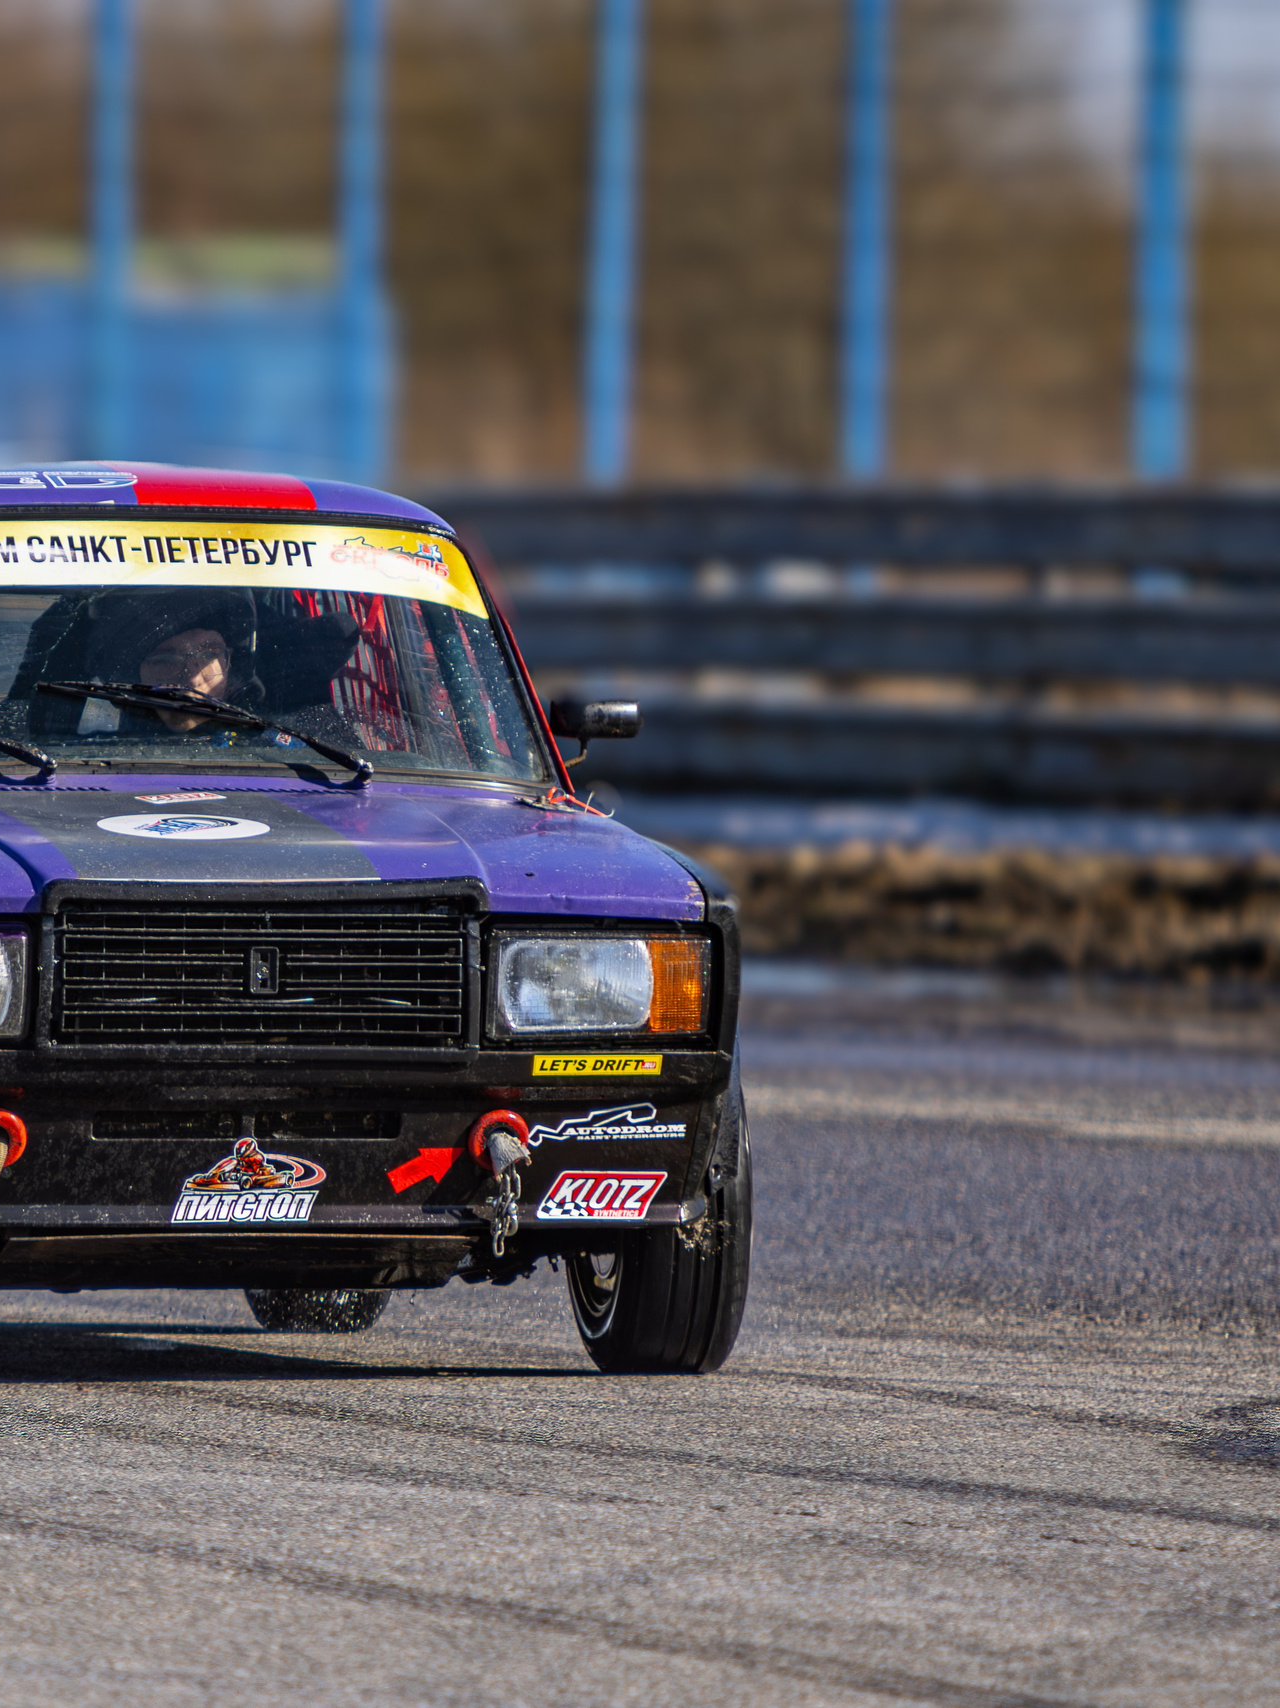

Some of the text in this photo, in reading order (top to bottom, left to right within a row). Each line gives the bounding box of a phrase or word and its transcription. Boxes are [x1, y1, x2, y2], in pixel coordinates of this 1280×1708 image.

[27, 535, 317, 568] САНКТ-ПЕТЕРБУРГ
[539, 1059, 587, 1072] LET'S
[562, 1124, 687, 1136] AUTODROM
[553, 1177, 657, 1209] KLOTZ
[174, 1192, 315, 1221] ПИТСТОП
[593, 1209, 640, 1217] SYNTHETICS
